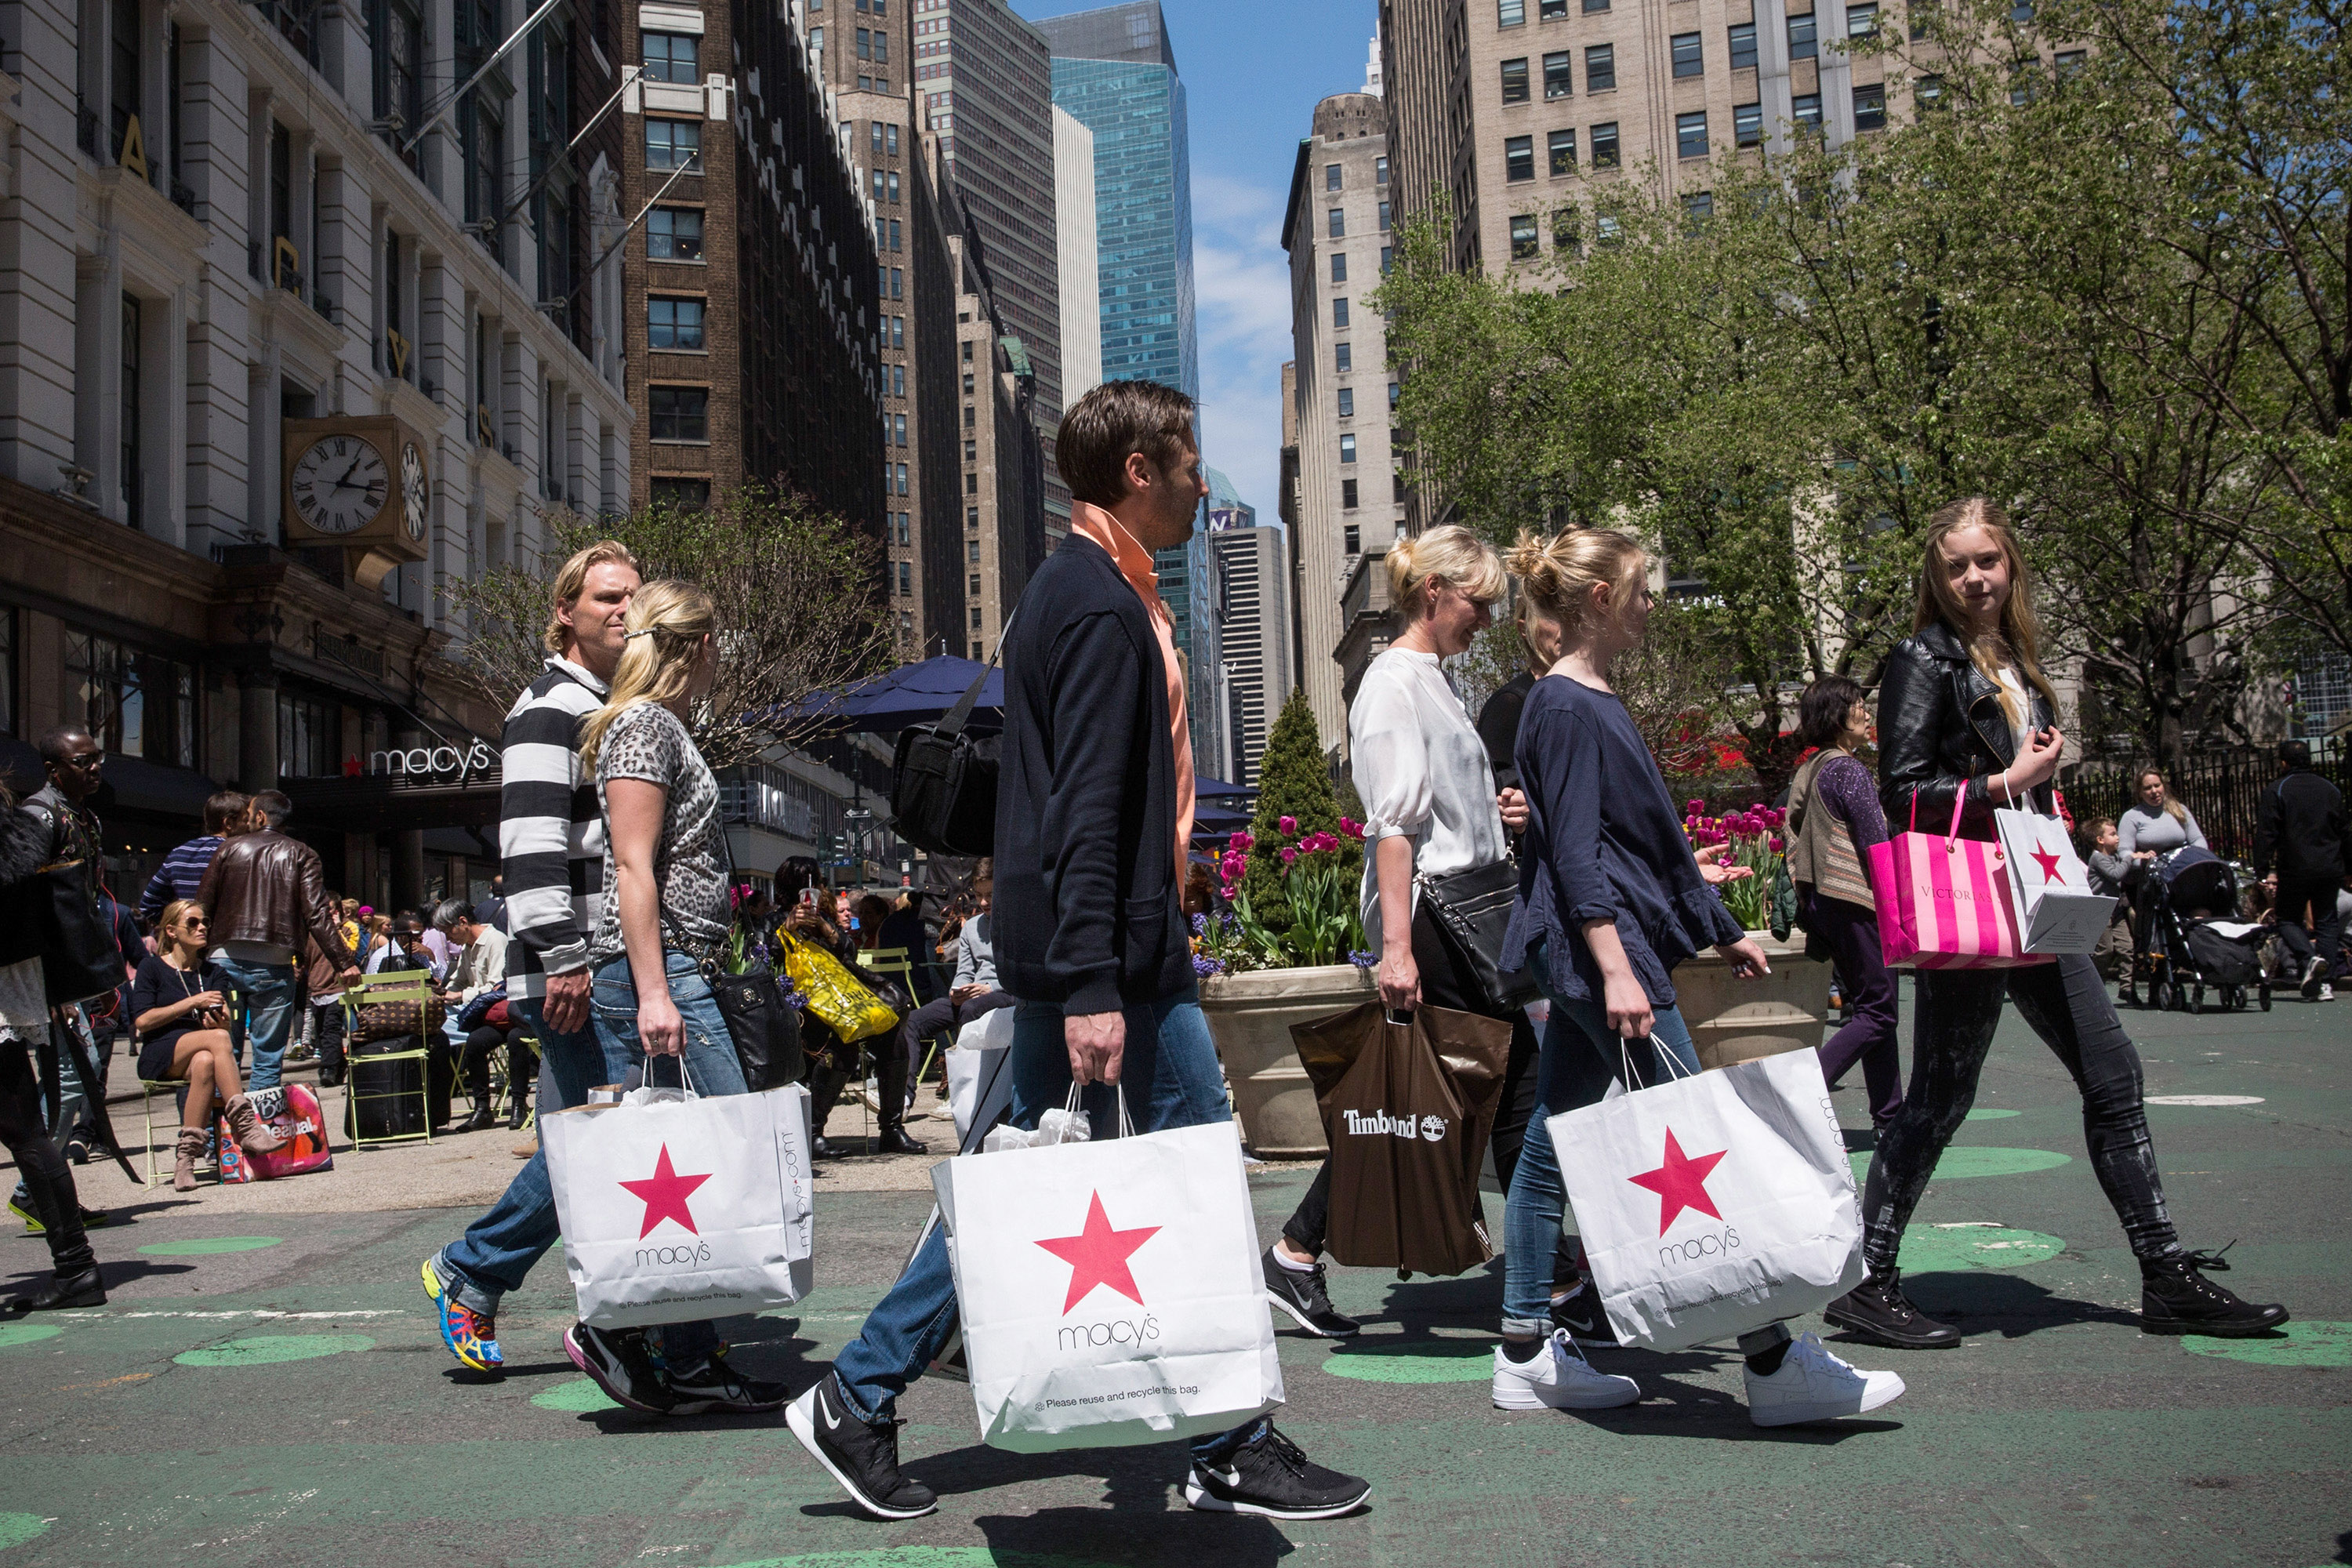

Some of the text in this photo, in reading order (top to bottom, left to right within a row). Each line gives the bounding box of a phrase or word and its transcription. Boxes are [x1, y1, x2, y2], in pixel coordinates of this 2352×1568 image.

[370, 735, 489, 779] macy's
[1921, 886, 1993, 903] VICTORIA'S
[635, 1240, 710, 1267] macy's
[1659, 1225, 1740, 1267] macy's
[687, 1294, 712, 1302] recycle
[1663, 1304, 1687, 1315] Please
[1687, 1299, 1708, 1309] reuse
[1709, 1294, 1724, 1303] and
[1724, 1287, 1752, 1301] recycle
[1752, 1280, 1767, 1291] this
[1058, 1313, 1160, 1351] macy's
[1046, 1385, 1201, 1409] Please reuse and recycle this bag.
